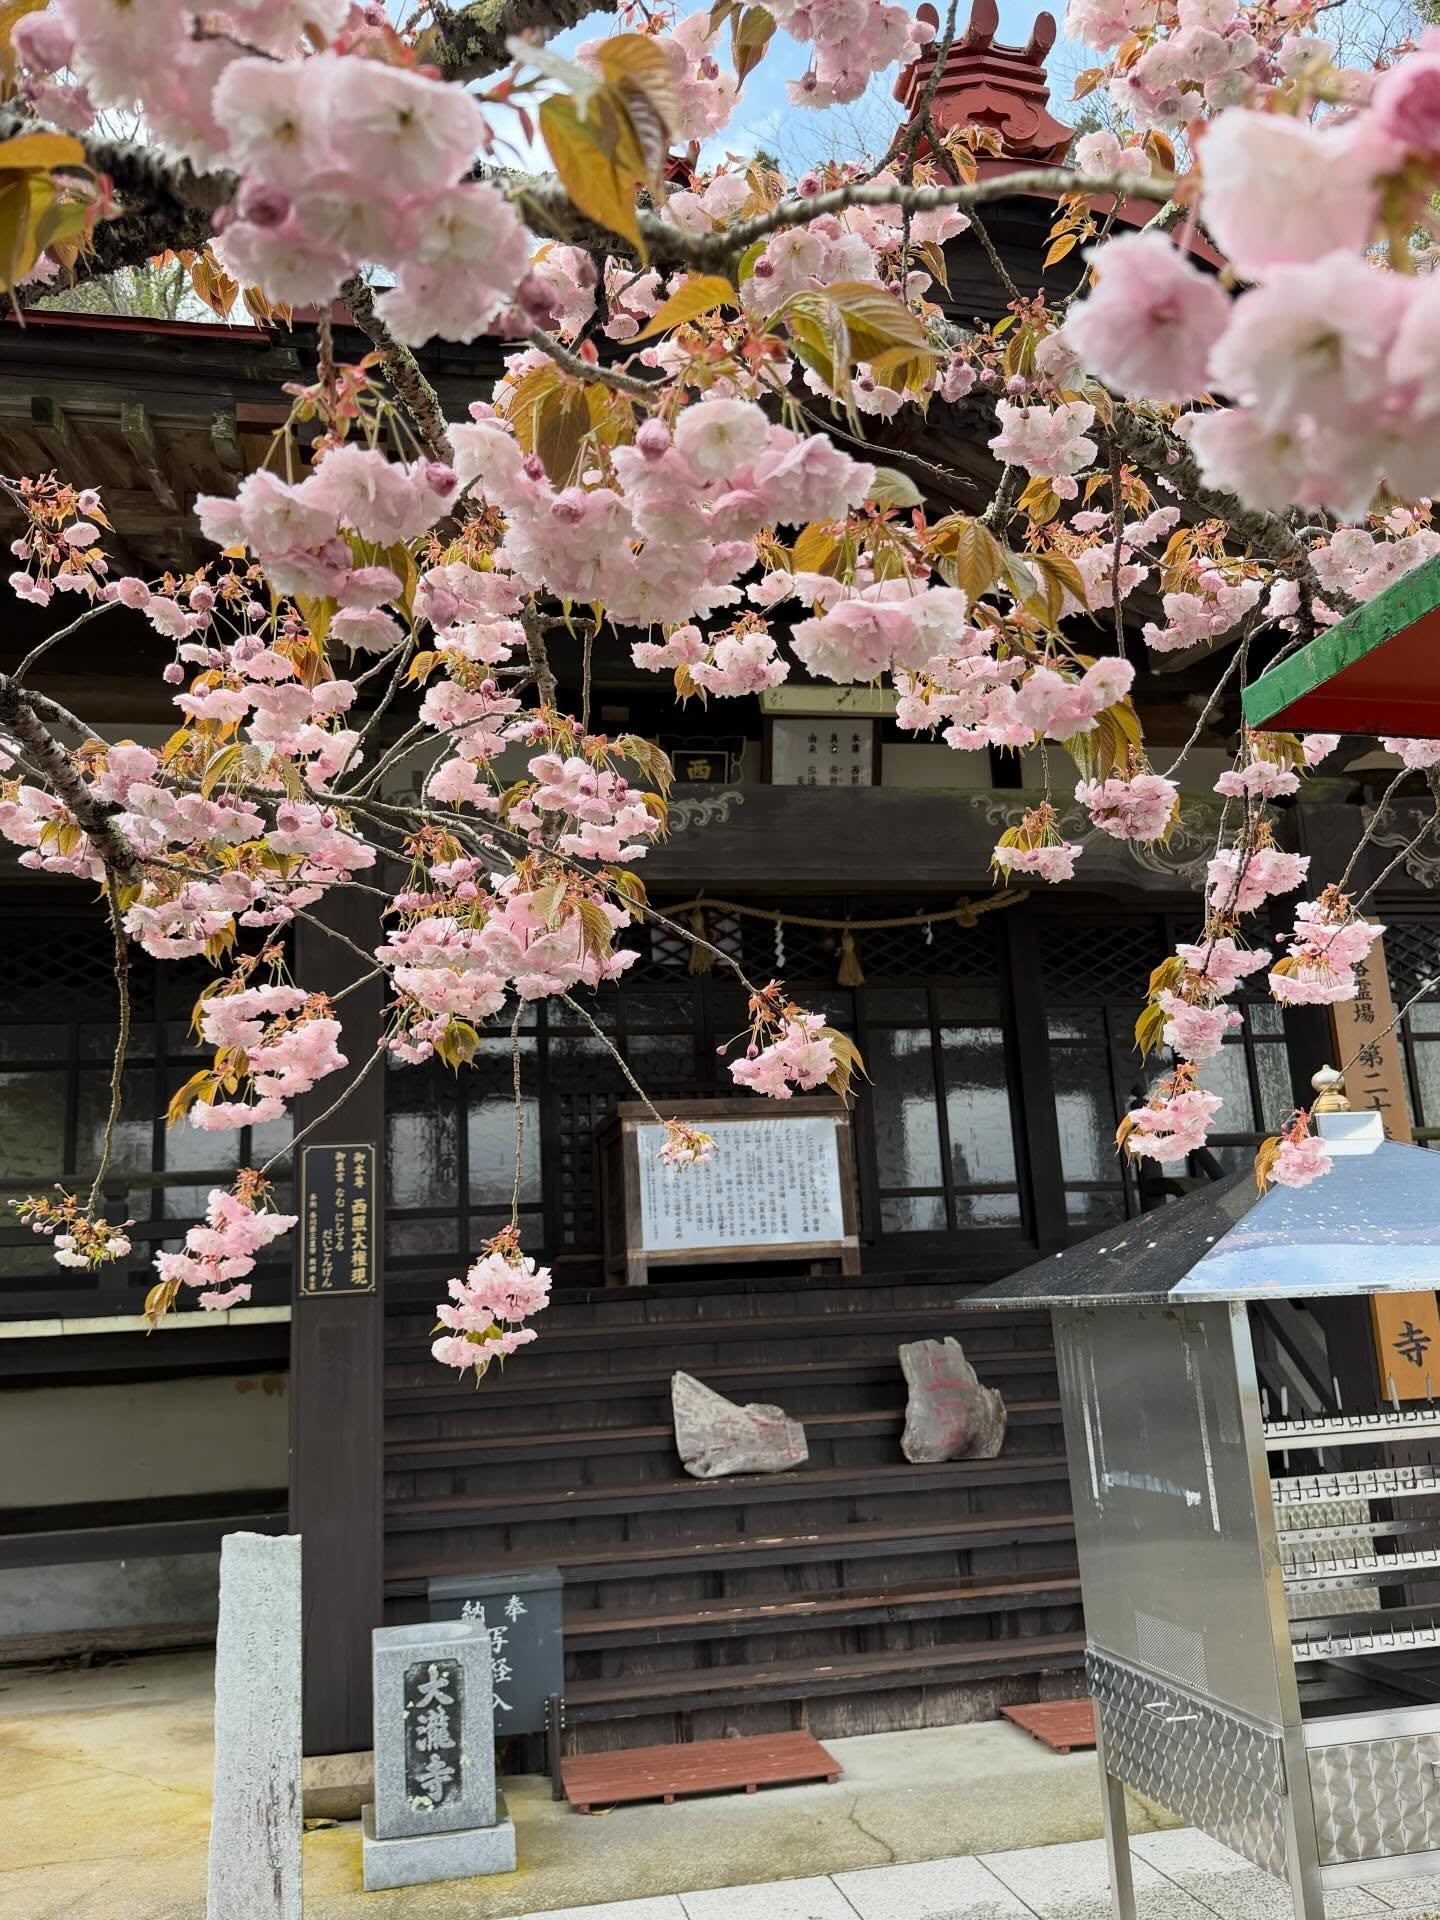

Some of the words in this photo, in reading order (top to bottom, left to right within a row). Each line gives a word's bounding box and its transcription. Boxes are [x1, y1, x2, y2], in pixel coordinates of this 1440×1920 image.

[686, 758, 713, 781] 西
[352, 1151, 367, 1189] 御本尊
[350, 1198, 369, 1285] 西照大権現
[1391, 1320, 1432, 1368] 寺
[504, 1594, 529, 1622] 奉
[414, 1663, 457, 1802] 大瀧寺
